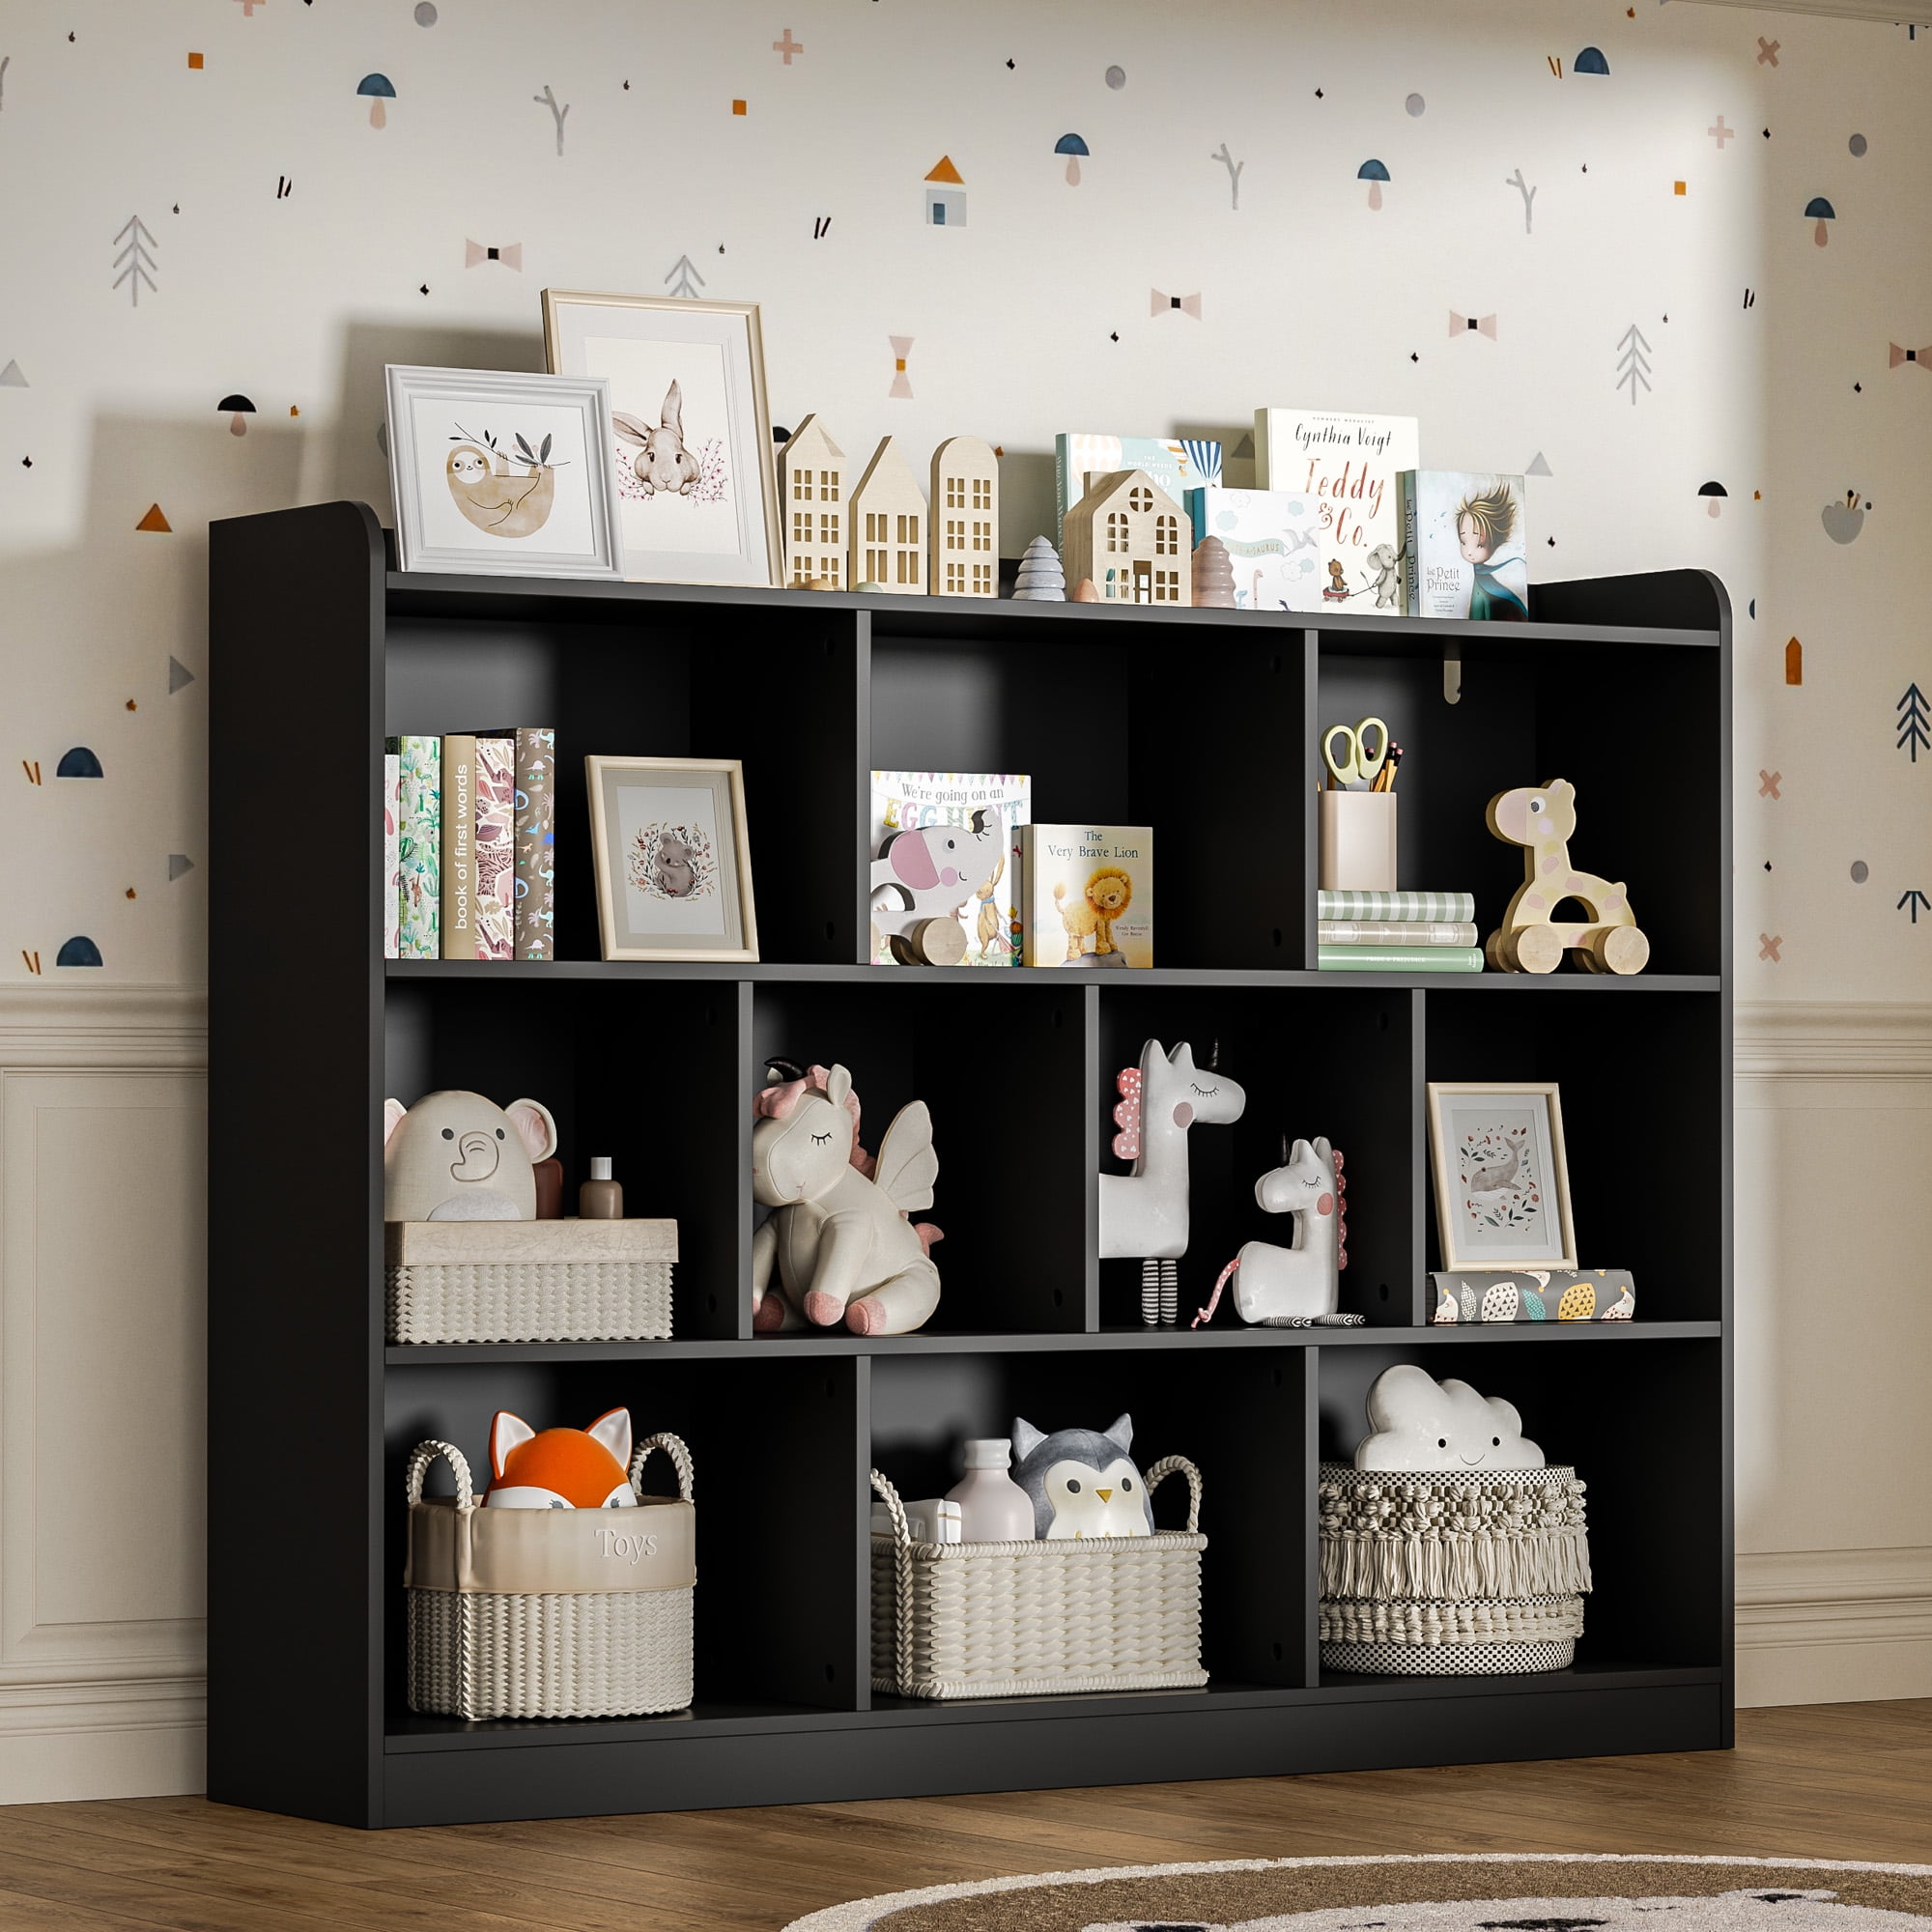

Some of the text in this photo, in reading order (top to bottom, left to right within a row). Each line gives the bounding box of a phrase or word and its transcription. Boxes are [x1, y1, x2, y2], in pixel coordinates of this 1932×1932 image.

[1295, 423, 1391, 456] Cynthia Voigt
[1305, 458, 1384, 520] Teddy
[1318, 502, 1368, 547] & Co.
[1407, 555, 1417, 600] Prince
[1427, 578, 1461, 593] Prince
[1436, 566, 1460, 581] Petit
[901, 782, 1004, 805] We're going on an
[883, 797, 938, 831] EGG
[455, 764, 468, 929] book of first words
[1084, 830, 1103, 841] The
[1048, 844, 1139, 861] Very Brave Lion
[594, 1529, 658, 1566] Toys
